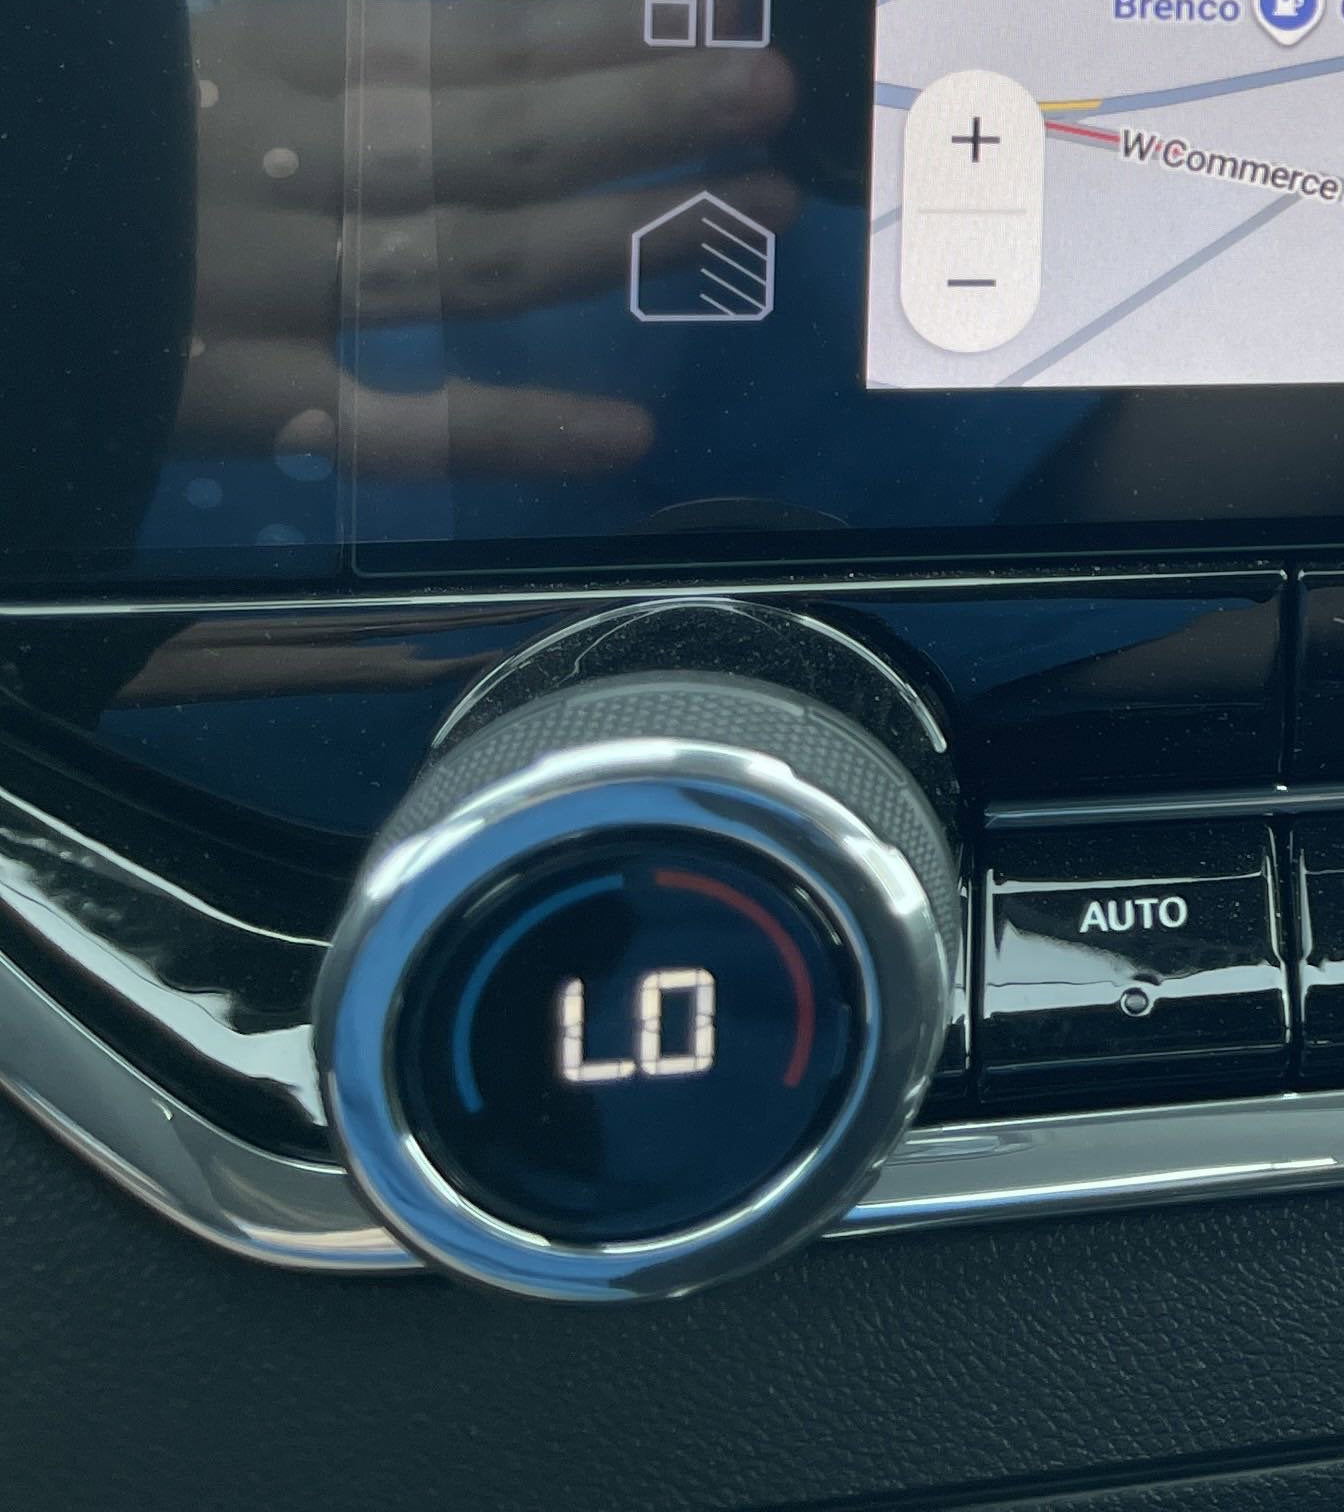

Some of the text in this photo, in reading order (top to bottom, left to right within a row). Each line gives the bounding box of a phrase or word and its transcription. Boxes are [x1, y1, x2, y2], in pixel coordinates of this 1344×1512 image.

[1120, 128, 1156, 163] W
[1161, 138, 1341, 204] Commerce
[1080, 896, 1189, 934] AUTO
[561, 967, 716, 1084] LO
